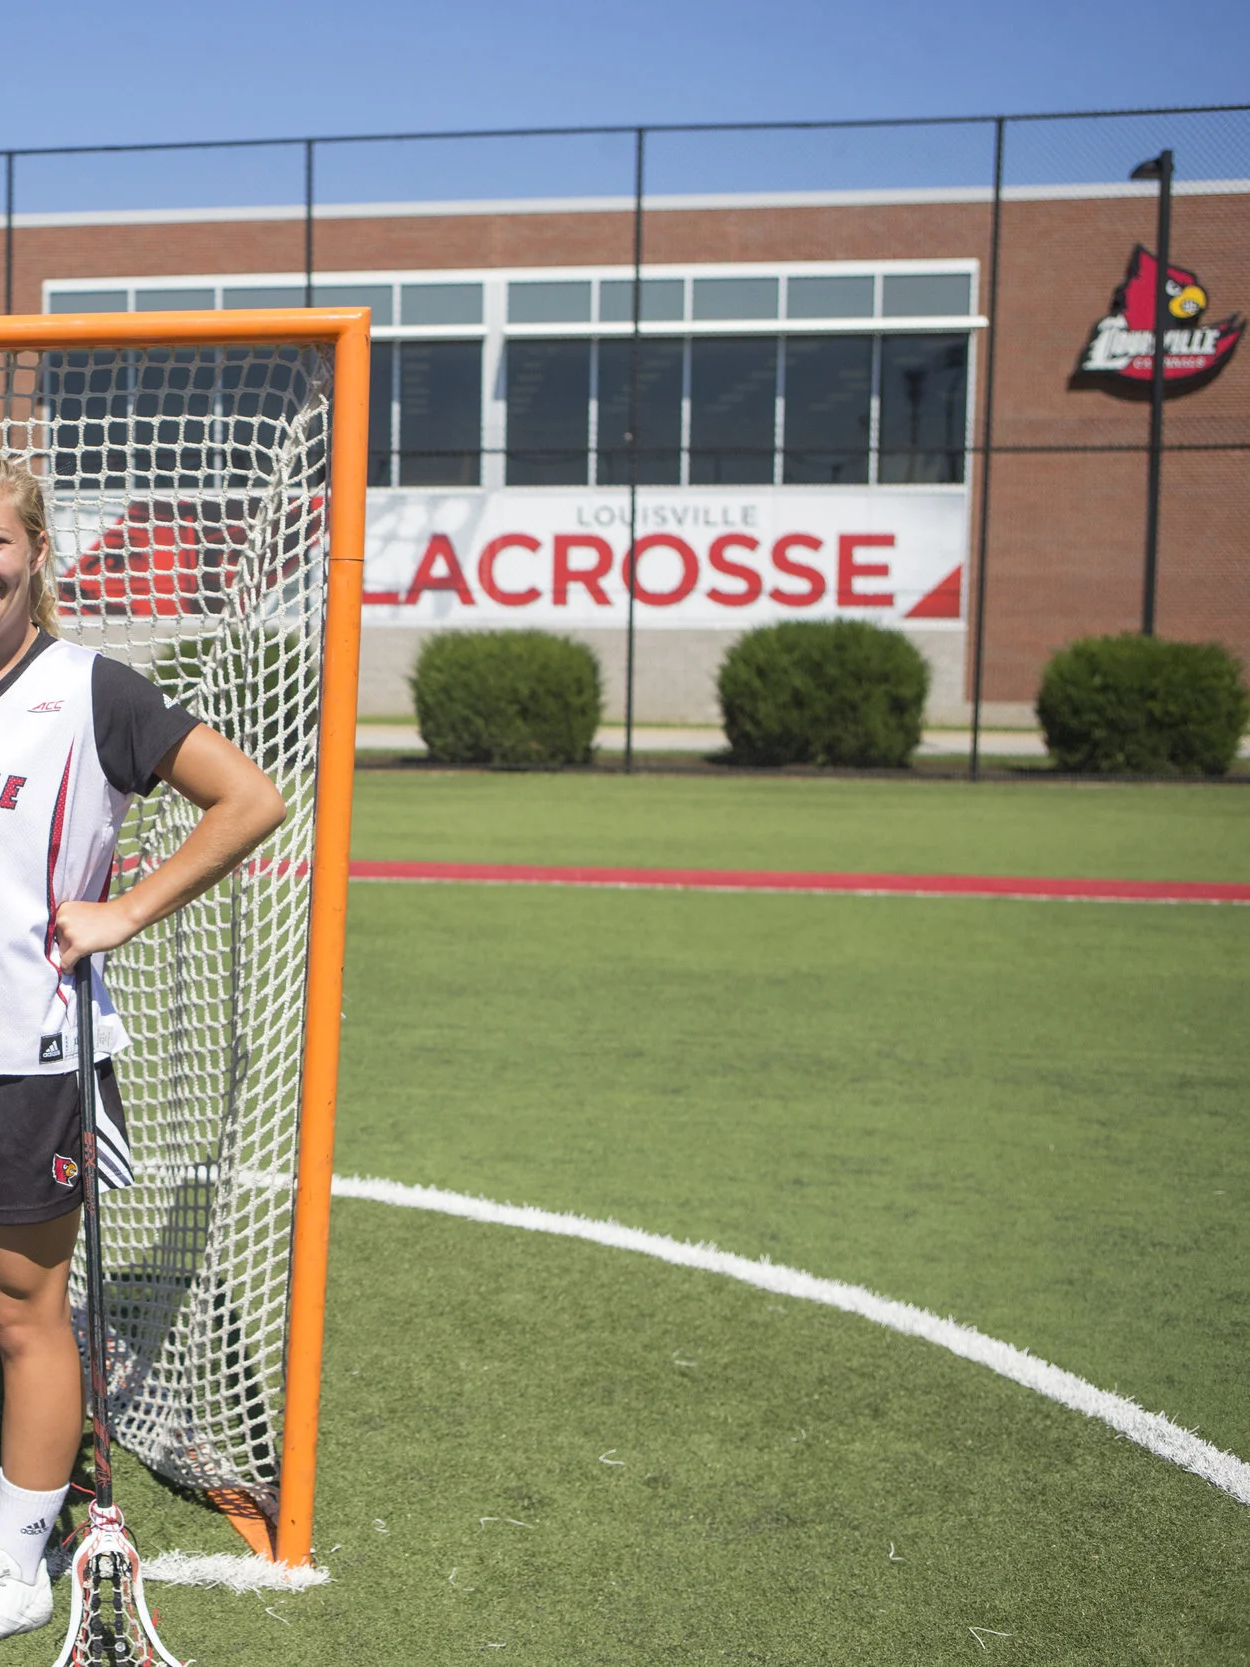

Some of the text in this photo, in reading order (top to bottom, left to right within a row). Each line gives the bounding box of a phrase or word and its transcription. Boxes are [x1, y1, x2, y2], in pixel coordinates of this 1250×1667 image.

[1082, 314, 1220, 371] LOUIVILLE
[576, 505, 758, 527] LOUISVILLE
[362, 532, 896, 607] ACROSSE
[30, 699, 66, 711] ACC
[83, 1131, 96, 1169] STX
